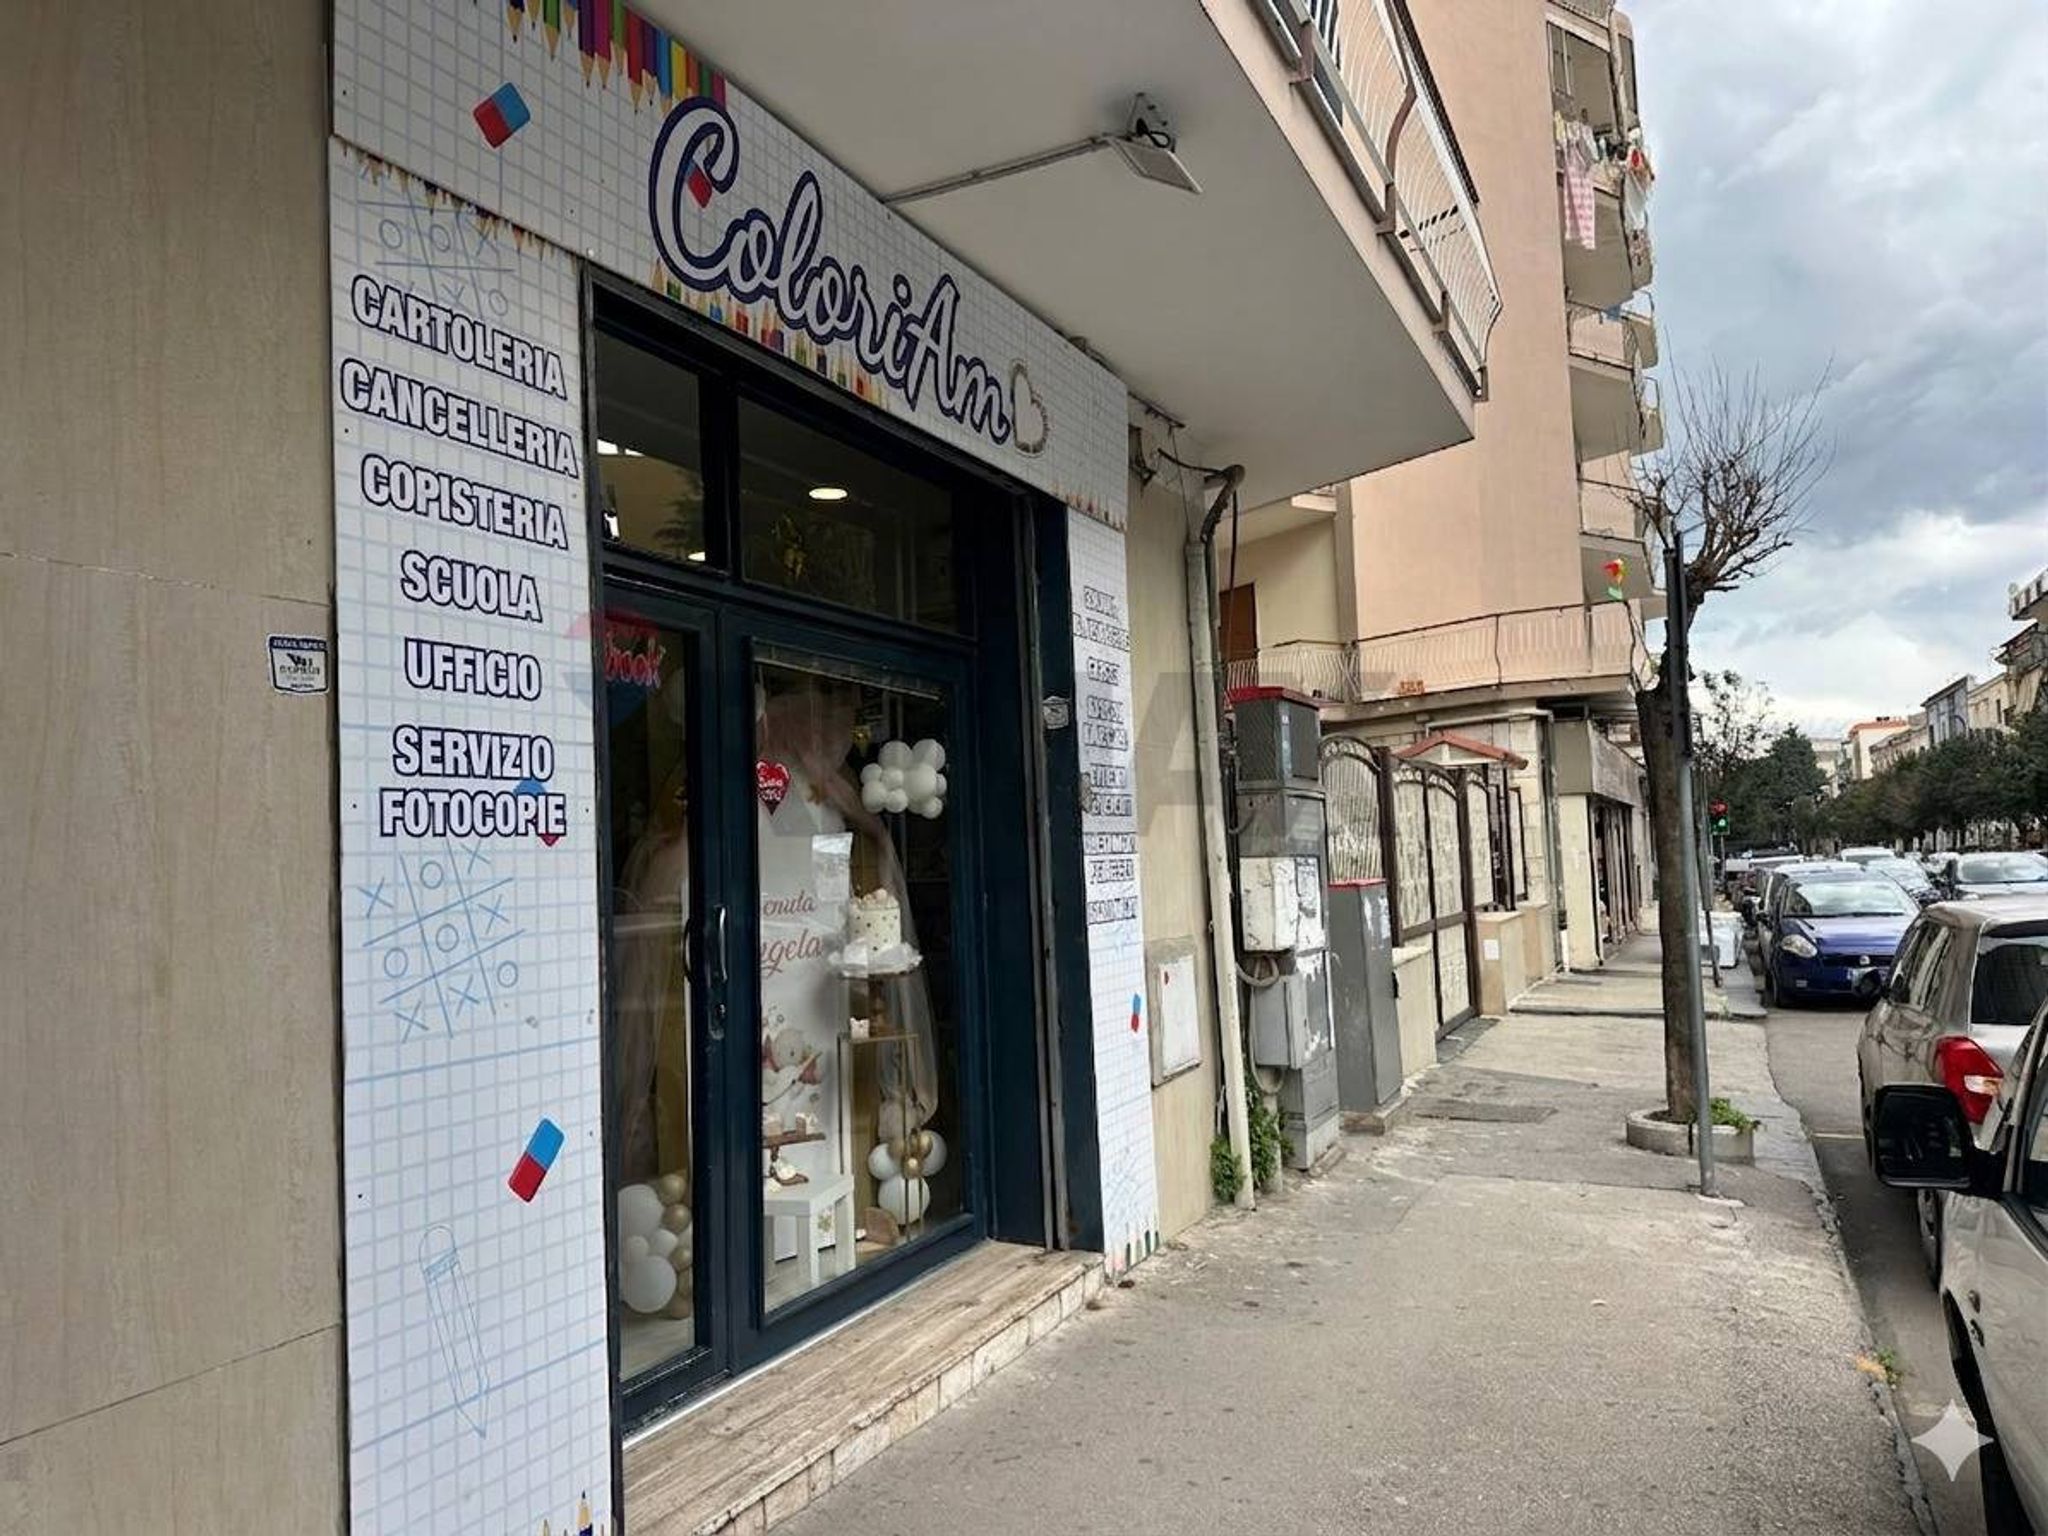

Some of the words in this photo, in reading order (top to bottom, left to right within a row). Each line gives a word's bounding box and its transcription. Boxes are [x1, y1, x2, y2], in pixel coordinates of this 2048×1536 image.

[352, 274, 568, 400] CARTOLERIA
[341, 357, 579, 479] CANCELLERIA
[361, 453, 568, 549] COPISTERIA
[401, 550, 542, 622] SCUOLA
[405, 637, 542, 700] UFFICIO
[393, 725, 554, 782] SERVIZIO
[380, 787, 566, 837] FOTOCOPIE
